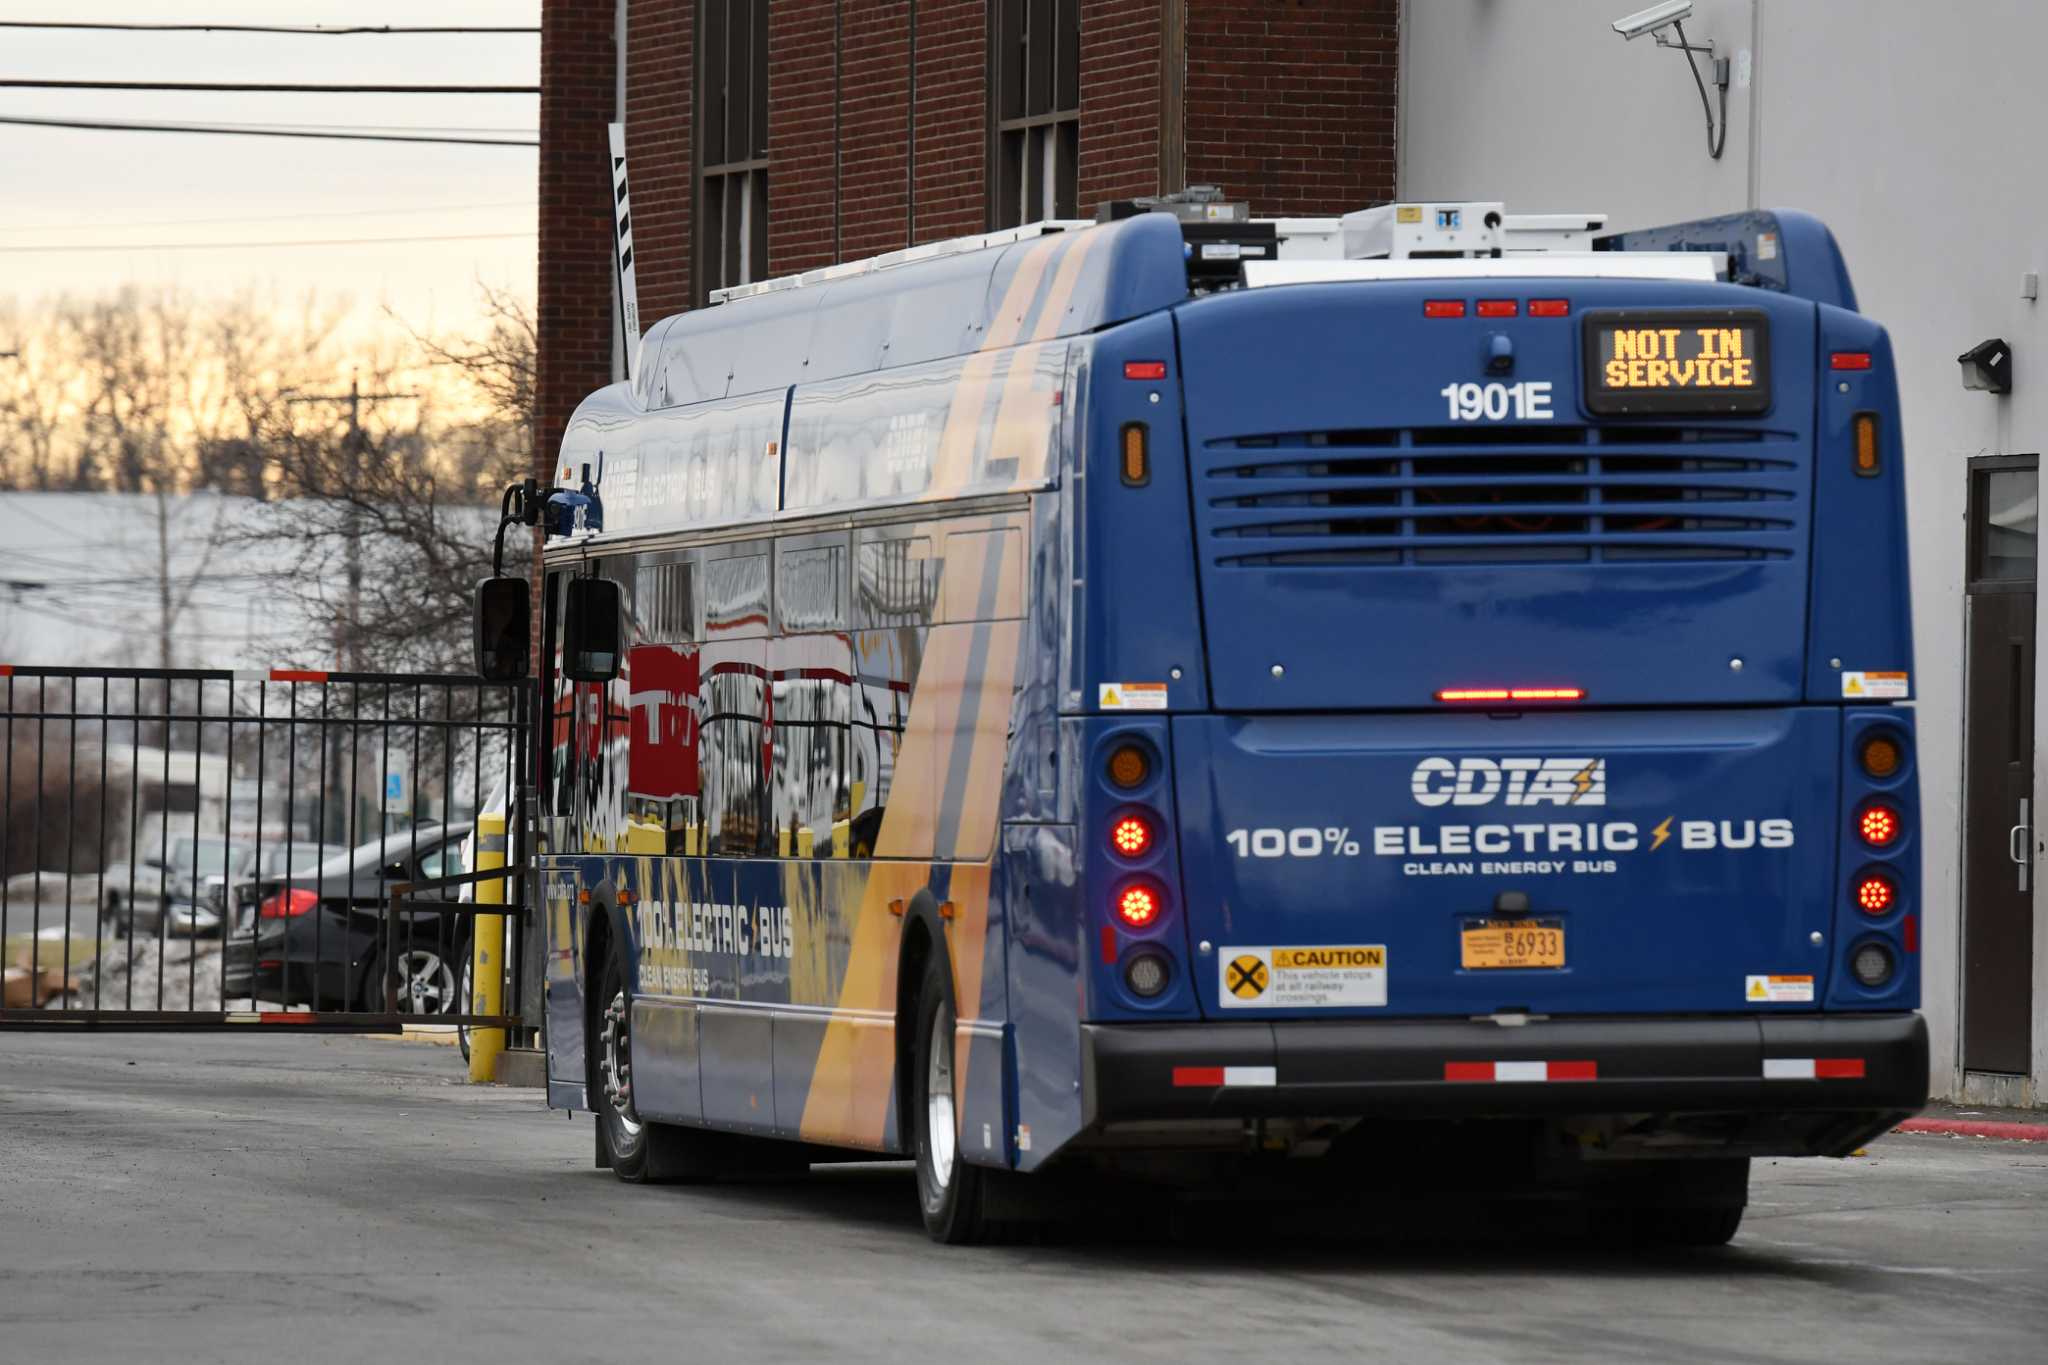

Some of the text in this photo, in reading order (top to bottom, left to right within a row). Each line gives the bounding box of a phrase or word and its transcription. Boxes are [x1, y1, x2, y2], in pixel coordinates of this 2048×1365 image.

[1614, 329, 1742, 360] NOT IN
[1606, 359, 1753, 387] SERVICE
[1441, 382, 1554, 420] 1901E
[1411, 757, 1606, 807] CDTA
[1226, 819, 1795, 857] 100% ELECTRIC BUS
[1403, 860, 1617, 875] CLEAN ENERGY BUS
[636, 900, 793, 958] 100% ELECTRIC BUS
[1516, 931, 1557, 957] 6933
[1293, 951, 1381, 966] CAUTION
[638, 964, 710, 992] CLEAN ENERGY BUS
[1276, 981, 1344, 993] at all railway
[1277, 970, 1373, 982] This vehicle stops
